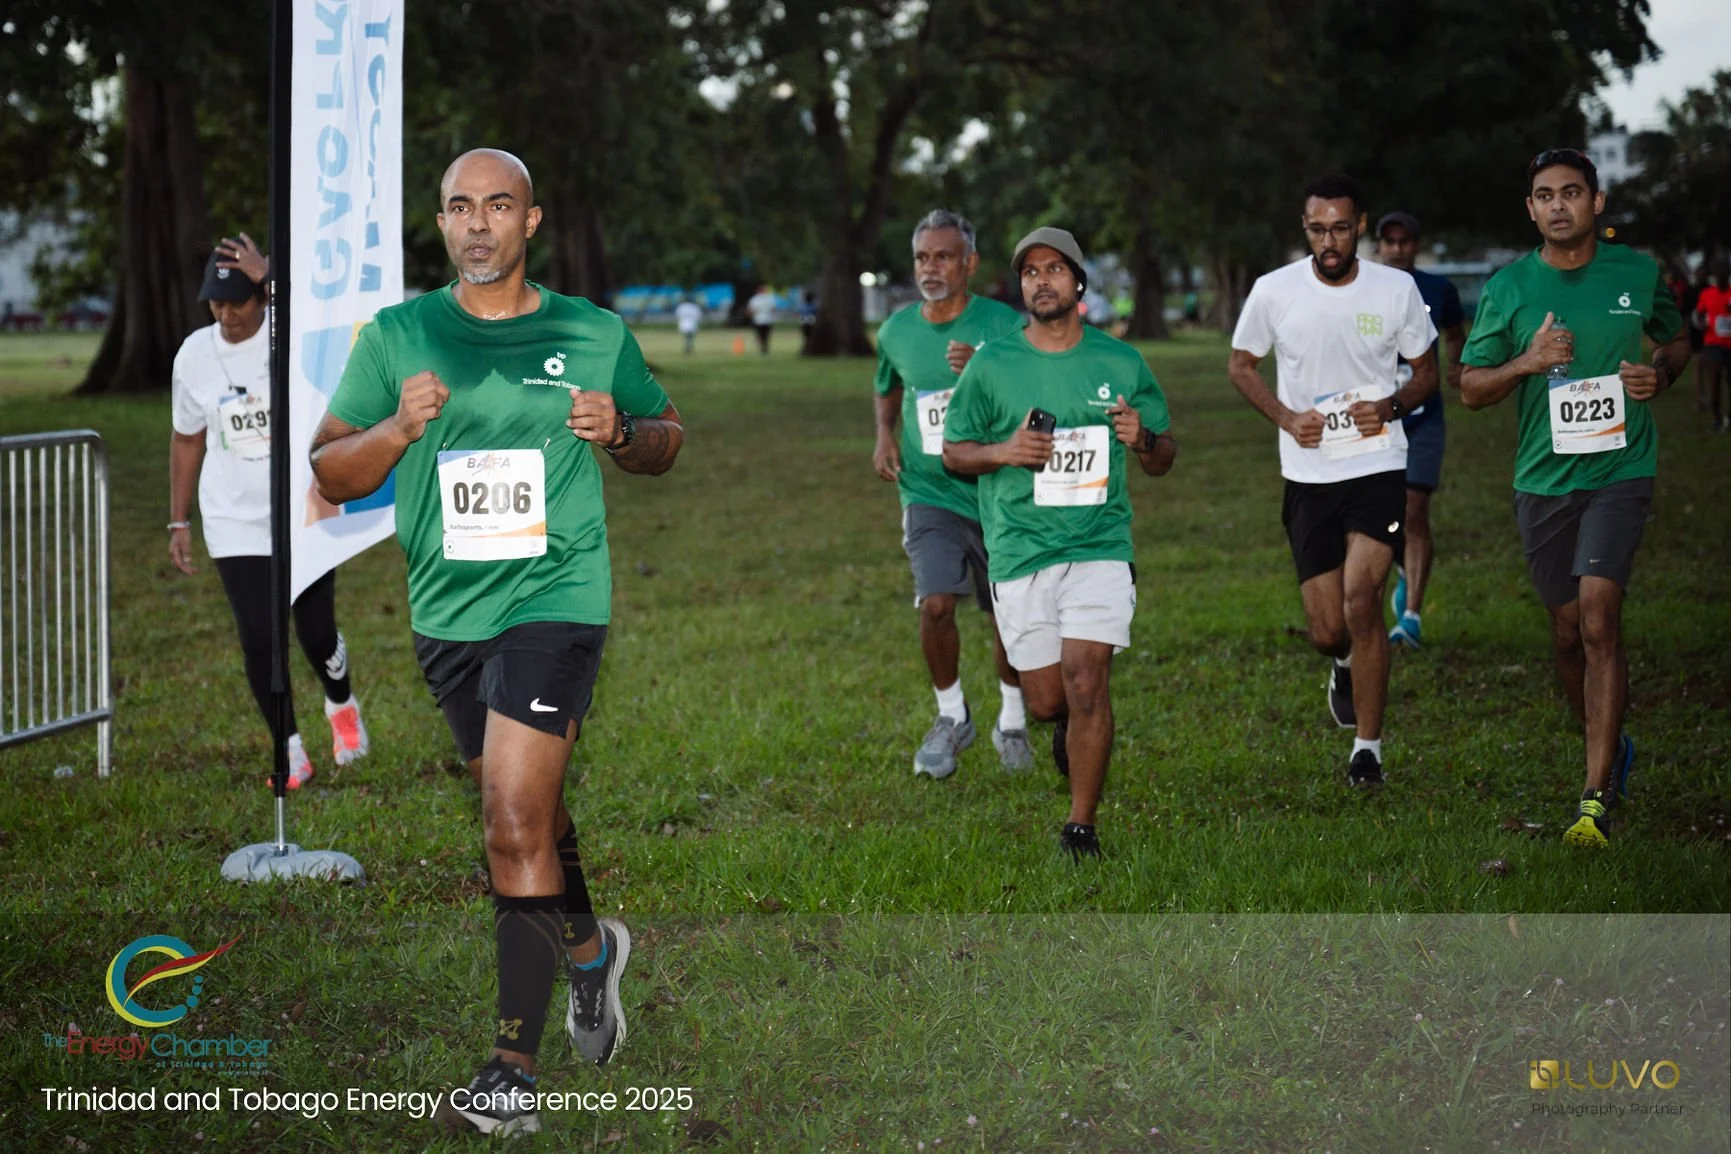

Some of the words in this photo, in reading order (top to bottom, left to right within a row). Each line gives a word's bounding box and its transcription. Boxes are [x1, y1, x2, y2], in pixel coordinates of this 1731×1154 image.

[523, 377, 548, 385] Trinidad
[1560, 397, 1615, 423] 0223
[1048, 449, 1097, 473] 0217
[453, 481, 532, 515] 0206
